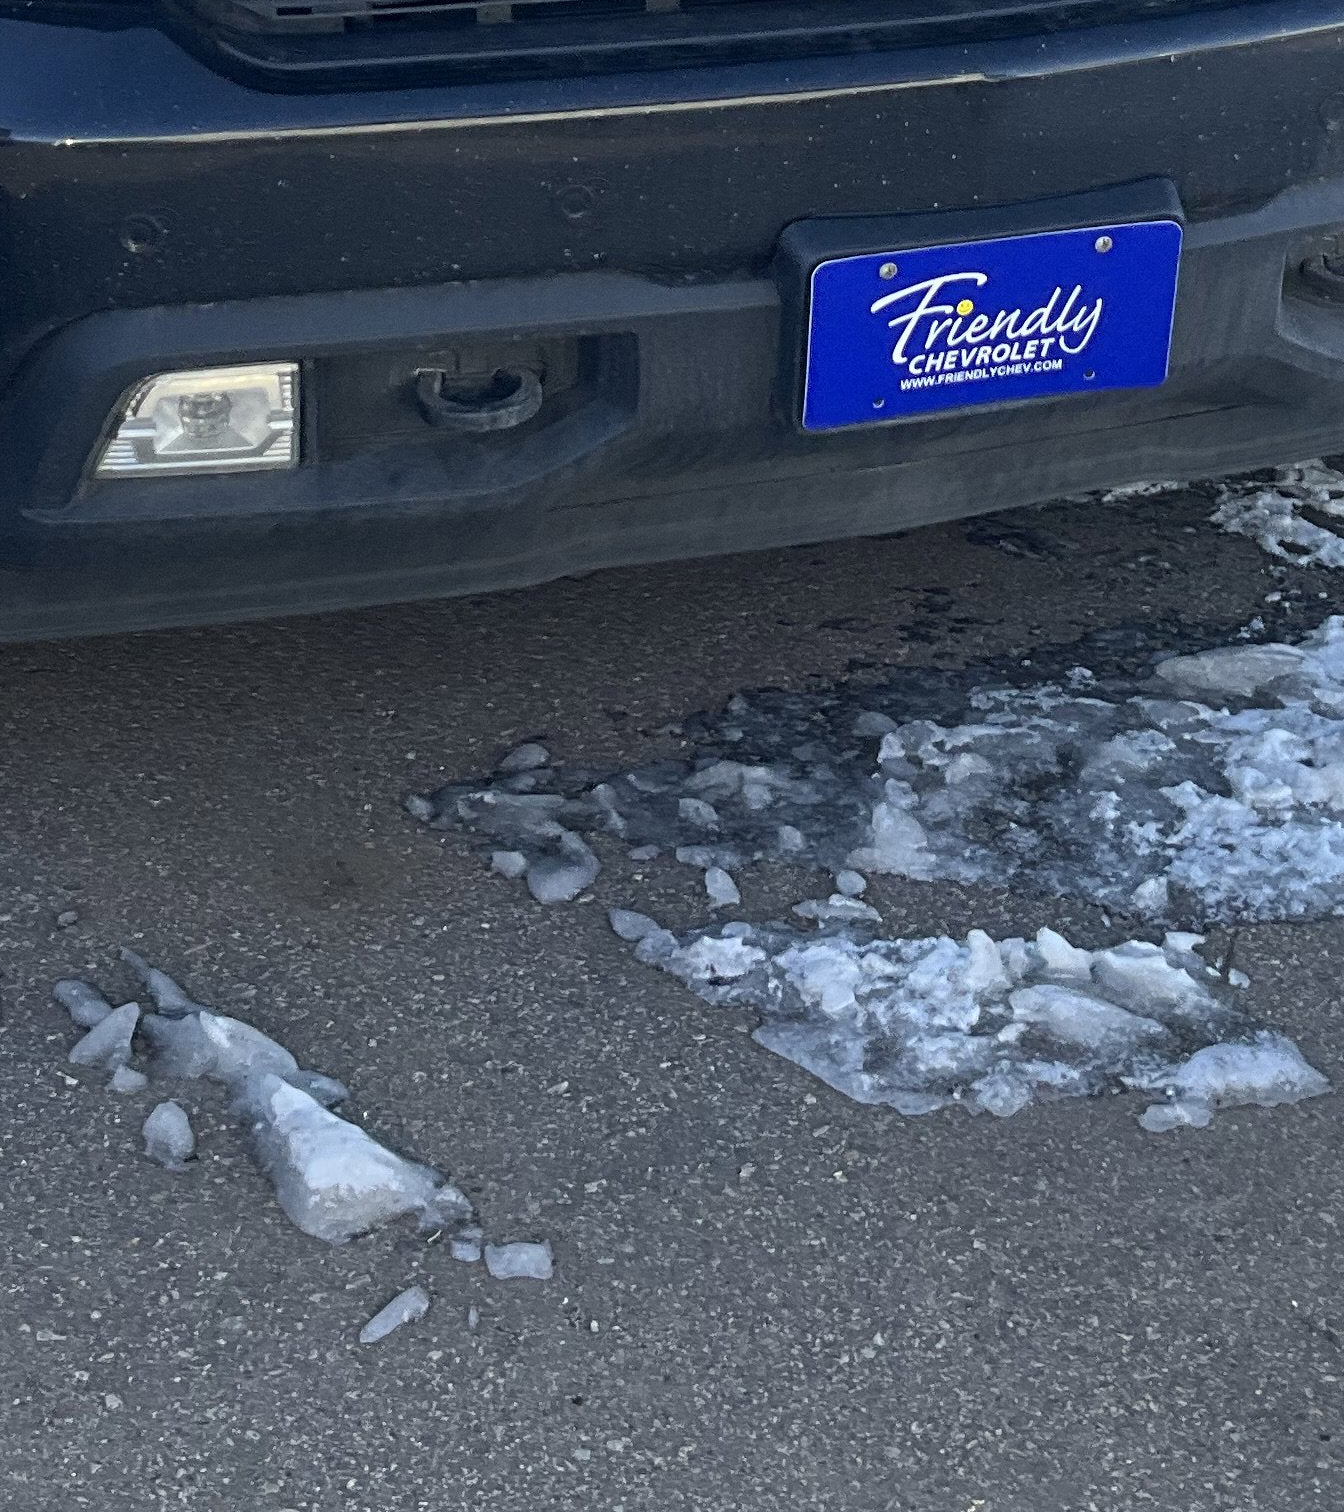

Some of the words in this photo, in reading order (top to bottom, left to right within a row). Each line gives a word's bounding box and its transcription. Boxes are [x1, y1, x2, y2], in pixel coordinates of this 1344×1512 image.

[870, 271, 1103, 364] Friendly
[908, 338, 1055, 374] CHEVROLET
[900, 359, 1063, 391] WWW.FRIENDLYCHEV.COM
